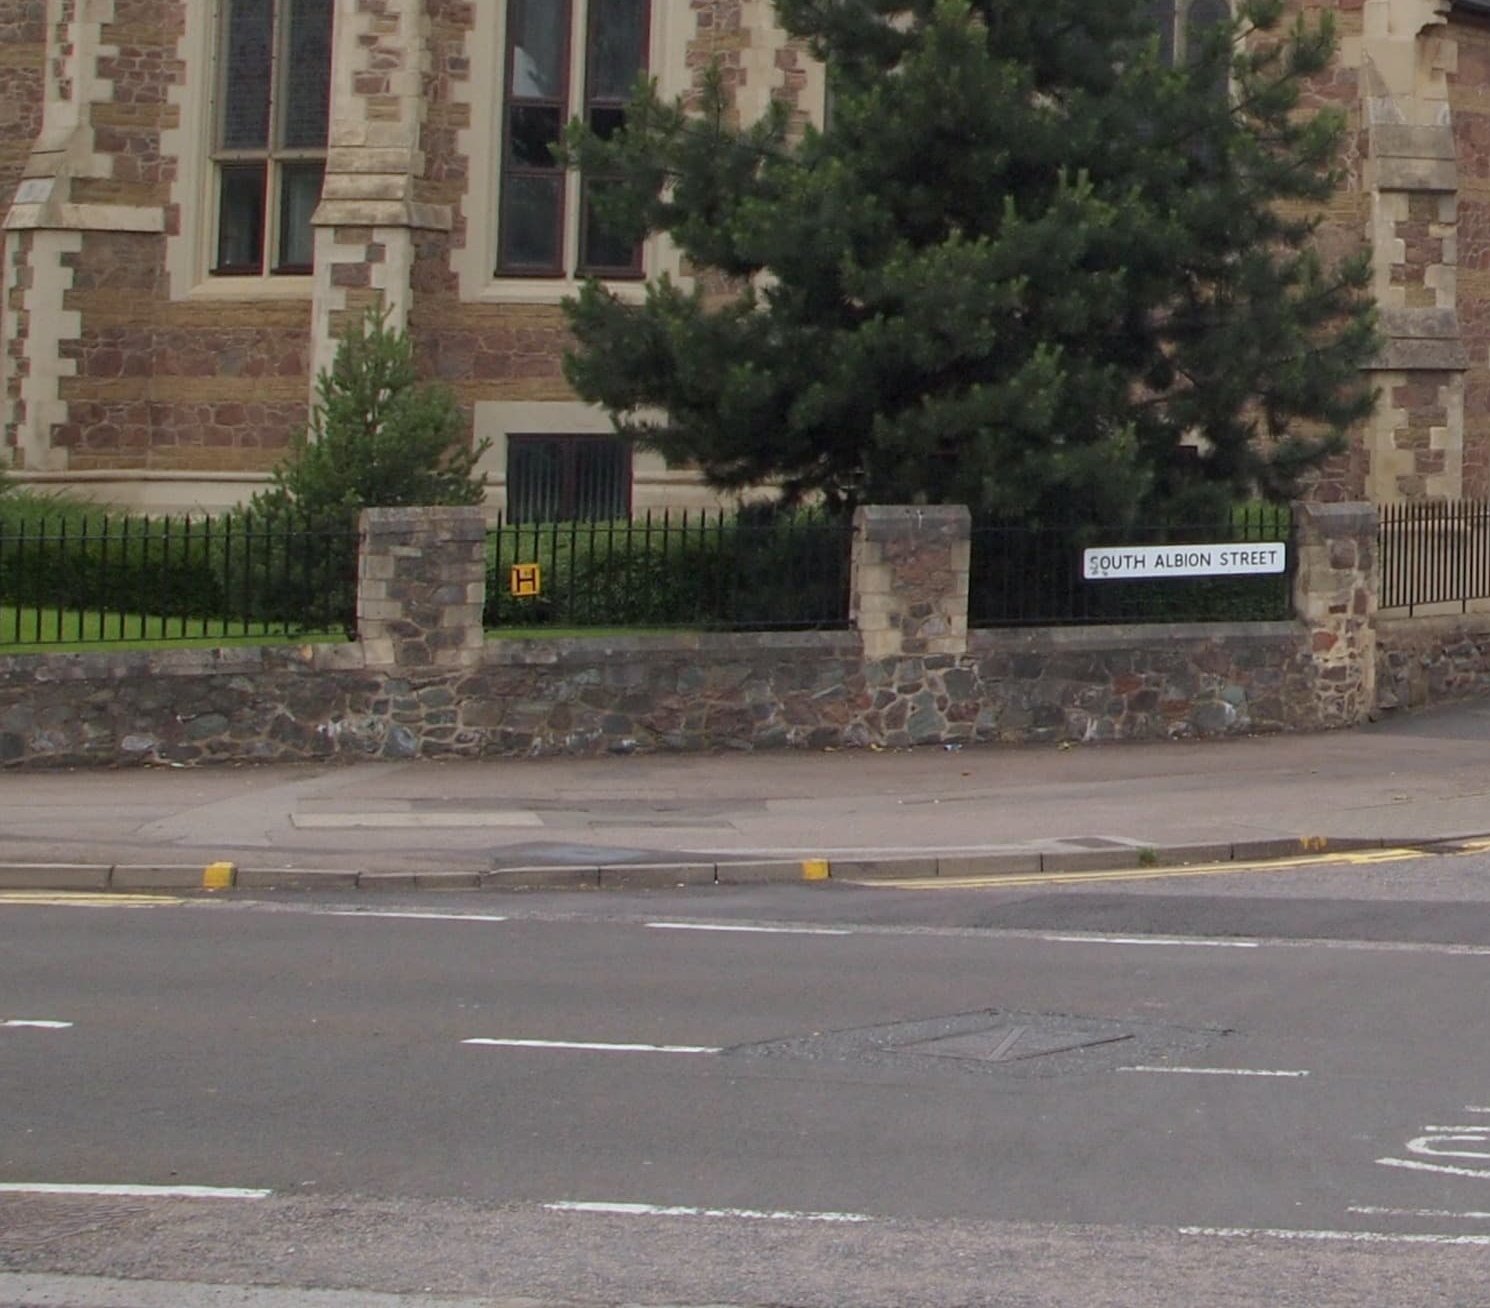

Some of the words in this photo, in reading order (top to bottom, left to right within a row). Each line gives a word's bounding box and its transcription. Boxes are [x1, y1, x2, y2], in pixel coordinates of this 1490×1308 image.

[1090, 555, 1145, 571] SOUTH
[1154, 552, 1211, 568] ALBION
[1219, 550, 1278, 566] STREET
[516, 567, 536, 593] H
